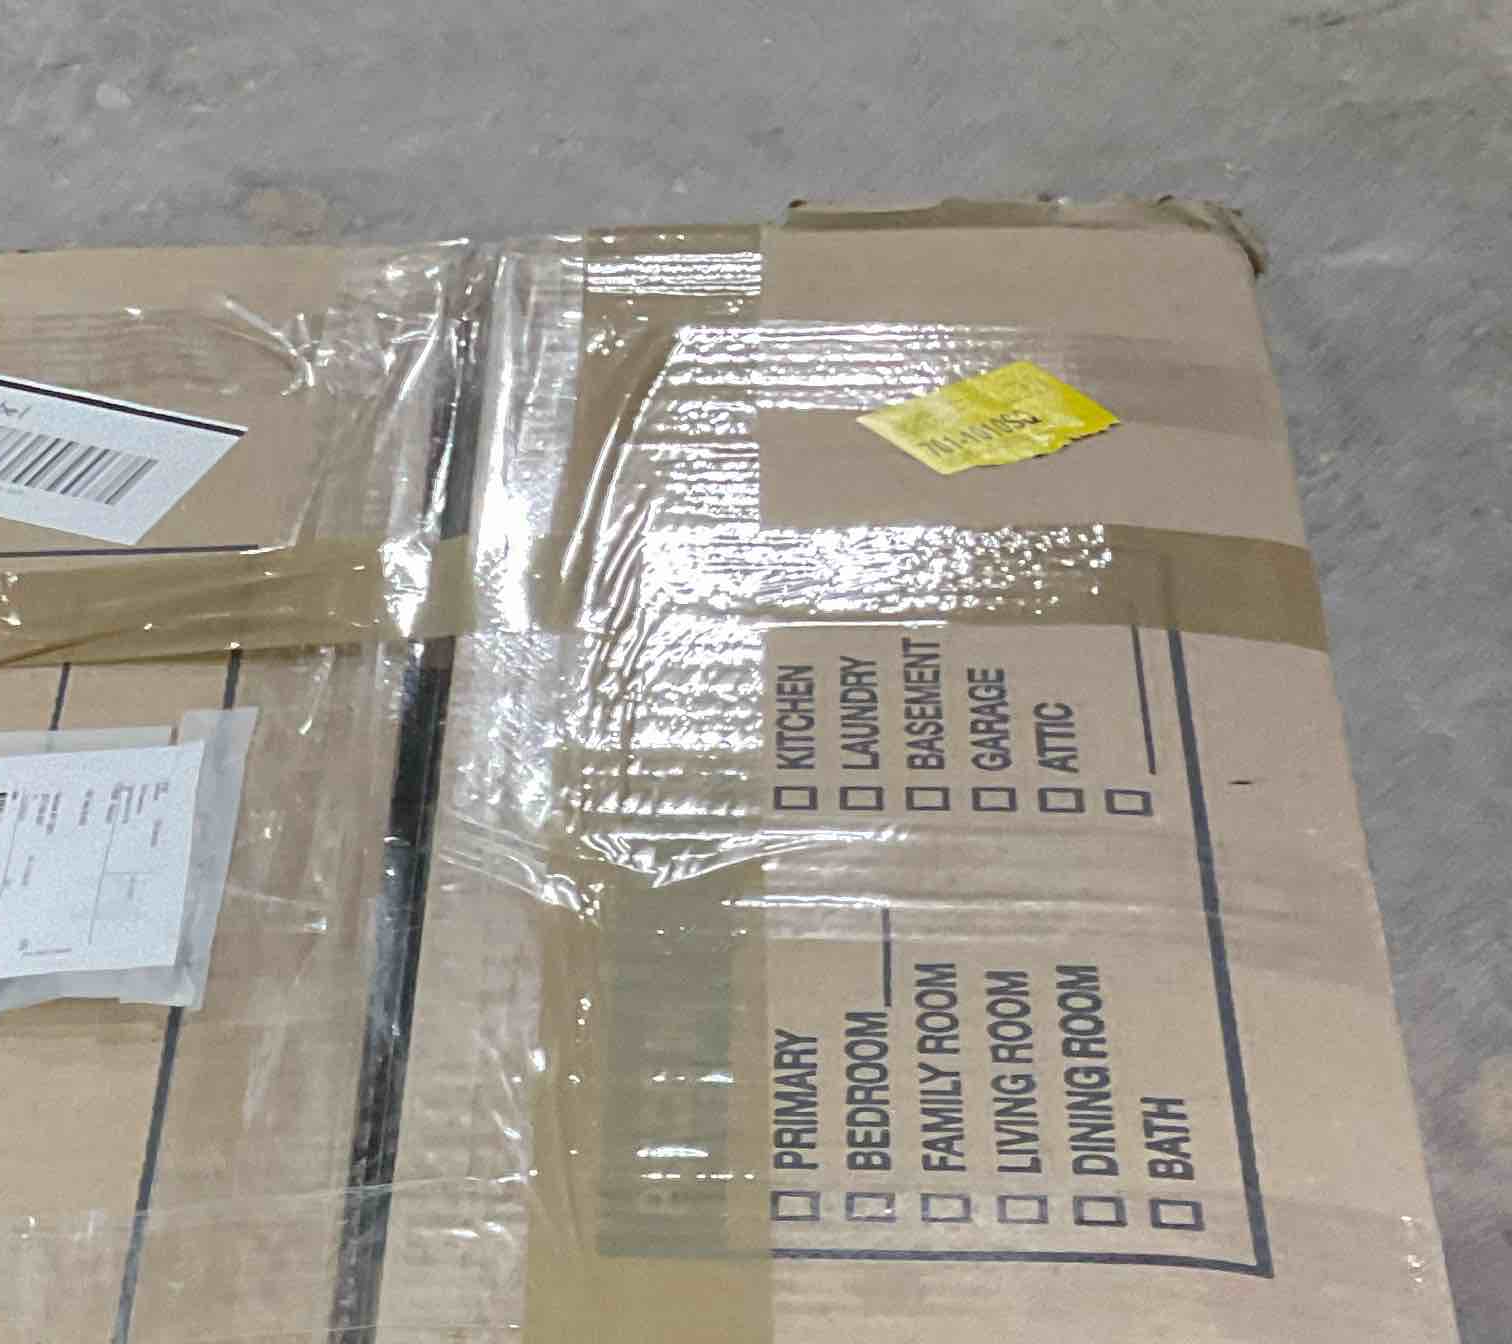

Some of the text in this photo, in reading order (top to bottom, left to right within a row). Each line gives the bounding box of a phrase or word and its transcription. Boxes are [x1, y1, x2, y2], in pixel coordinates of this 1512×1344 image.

[776, 665, 817, 770] KITCHEN
[839, 656, 880, 770] LAUNDRY
[902, 637, 945, 770] BASEMENT
[967, 667, 1013, 771] GARAGE
[1033, 701, 1079, 773] ATTIC
[773, 1028, 819, 1170] PRIMARY
[844, 1011, 892, 1171] BEDROOM
[914, 963, 967, 1172] FAMILY ROOM
[984, 970, 1042, 1174] LIVING ROOM
[1055, 964, 1119, 1176] DINING ROOM
[1140, 1096, 1194, 1180] BATH
